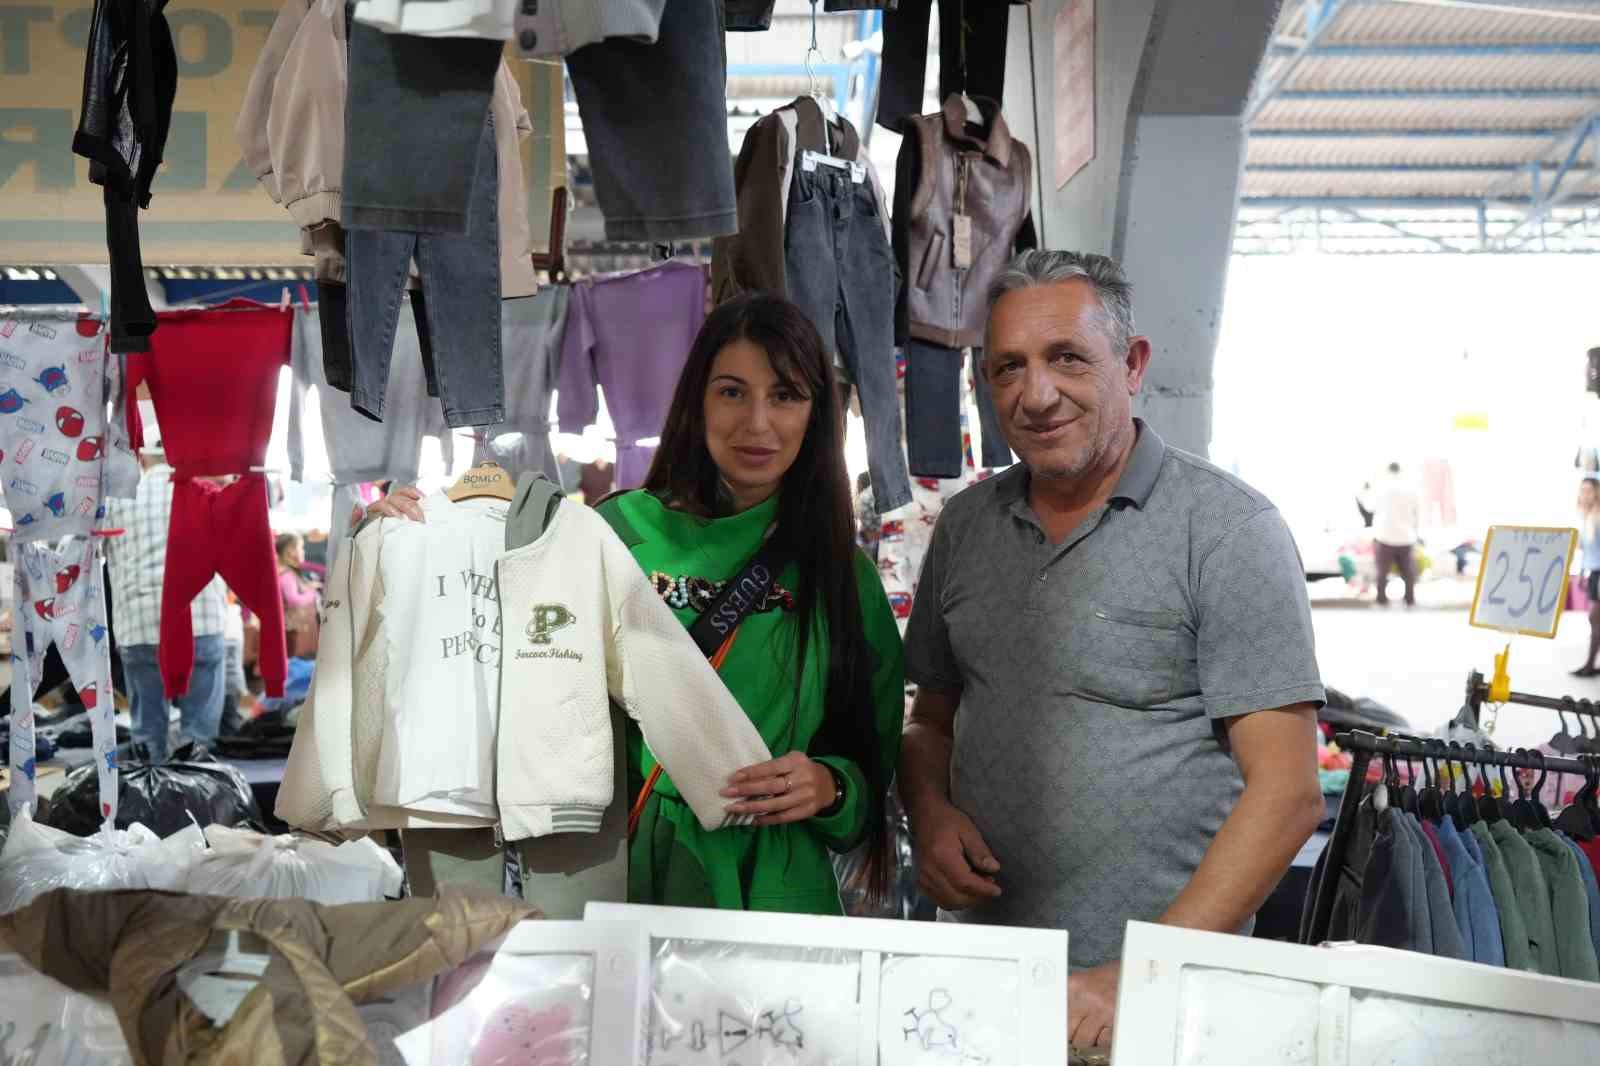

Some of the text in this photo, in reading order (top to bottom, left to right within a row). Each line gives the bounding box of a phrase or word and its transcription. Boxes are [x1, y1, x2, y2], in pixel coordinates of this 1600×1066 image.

[437, 575, 448, 597] I
[710, 564, 770, 635] GUESS
[1487, 547, 1565, 618] 250
